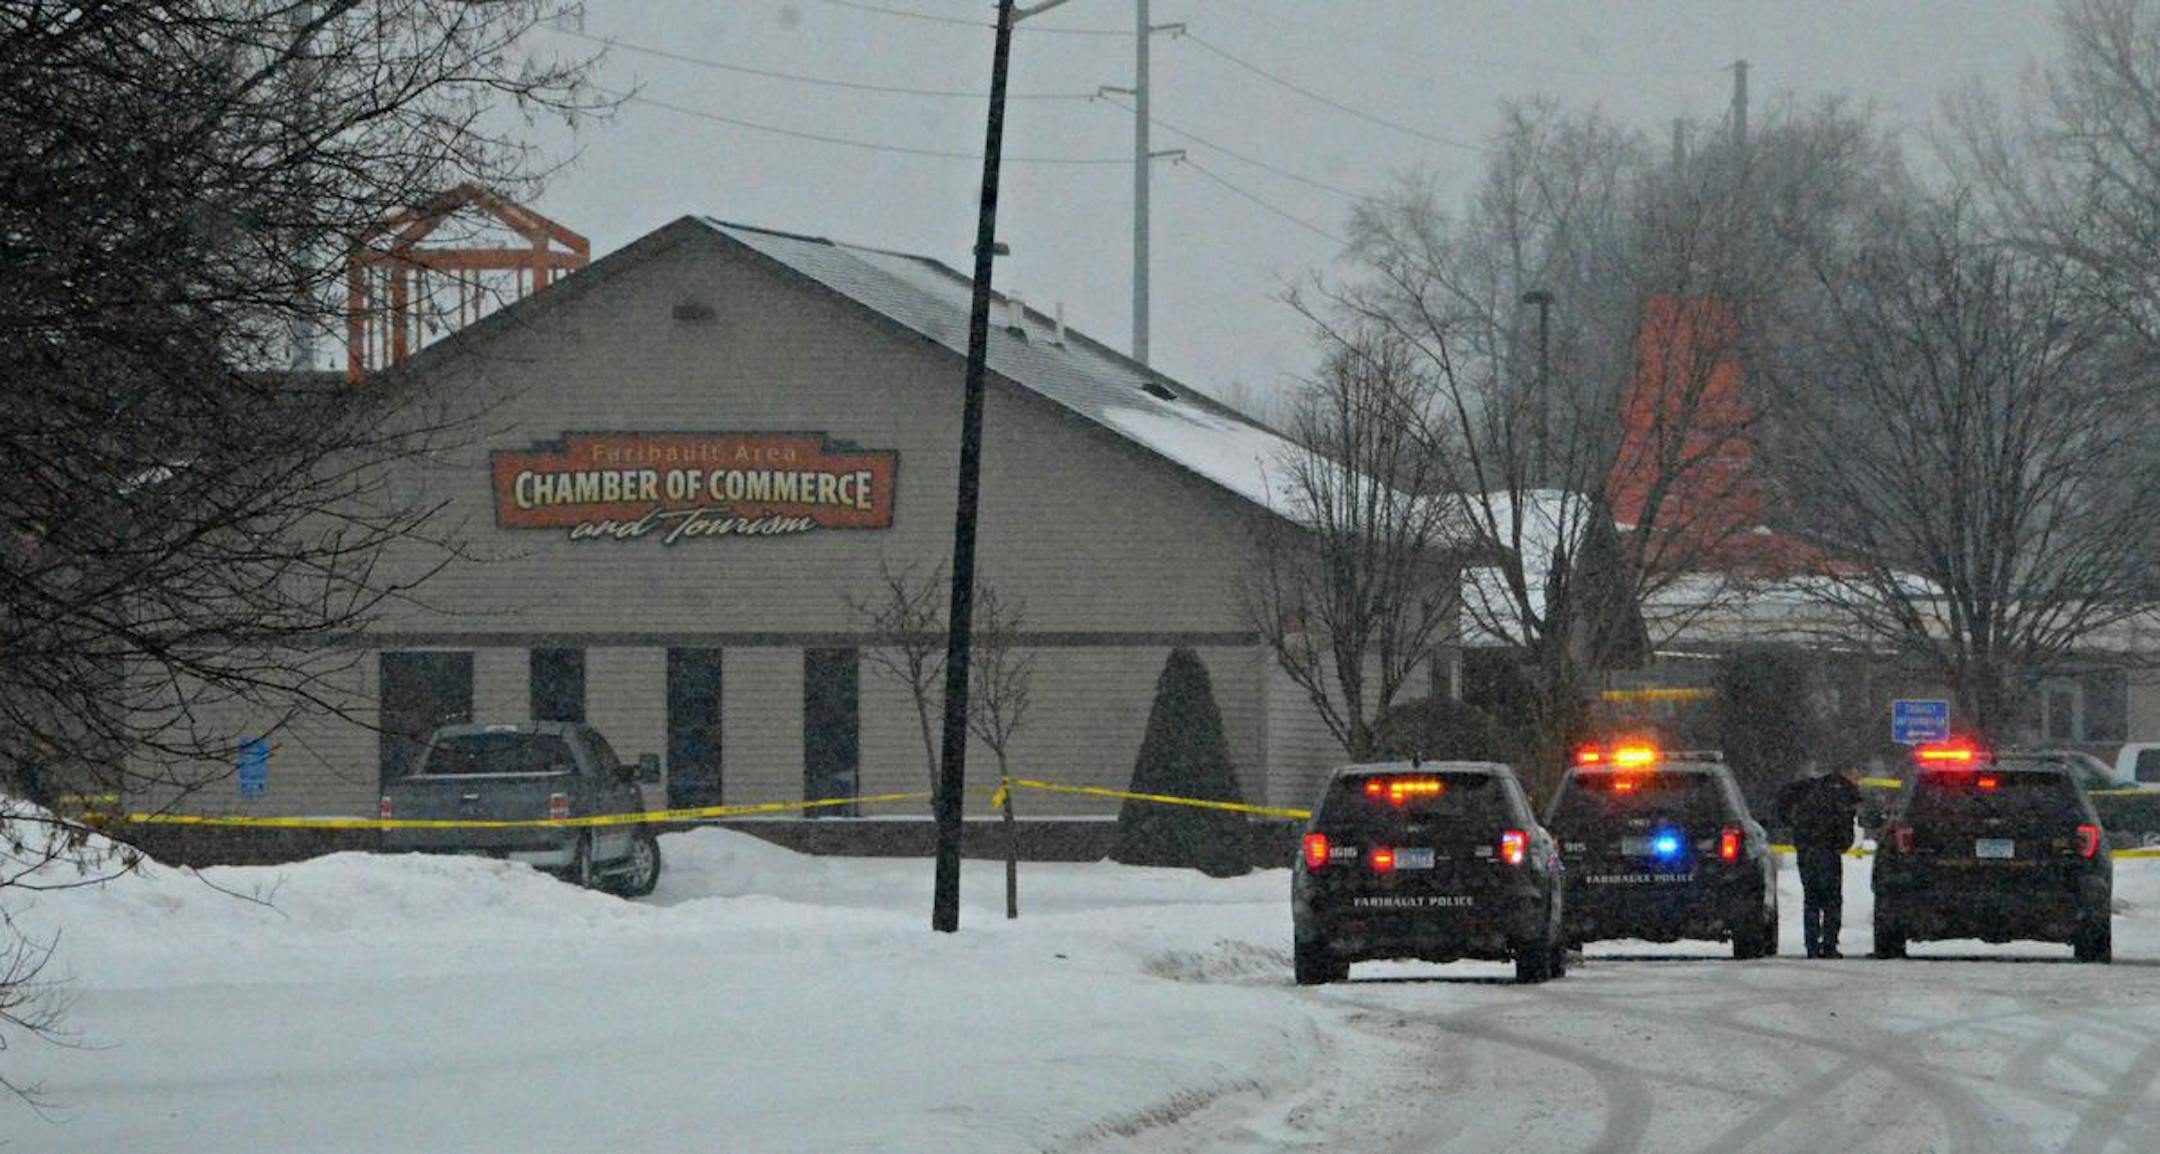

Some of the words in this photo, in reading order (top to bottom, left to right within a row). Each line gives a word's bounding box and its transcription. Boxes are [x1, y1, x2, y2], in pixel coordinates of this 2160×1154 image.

[592, 443, 722, 462] Faribault
[734, 445, 797, 462] Area
[514, 469, 659, 509] CHAMBER
[666, 469, 703, 499] OF
[709, 470, 873, 510] COMMERCE
[570, 505, 664, 540] and
[657, 505, 816, 545] Tourism
[1586, 874, 1650, 886] FARIBAULT
[1654, 872, 1696, 883] POLICE
[1353, 896, 1425, 908] FARIBAULT
[1428, 896, 1474, 908] POLICE
